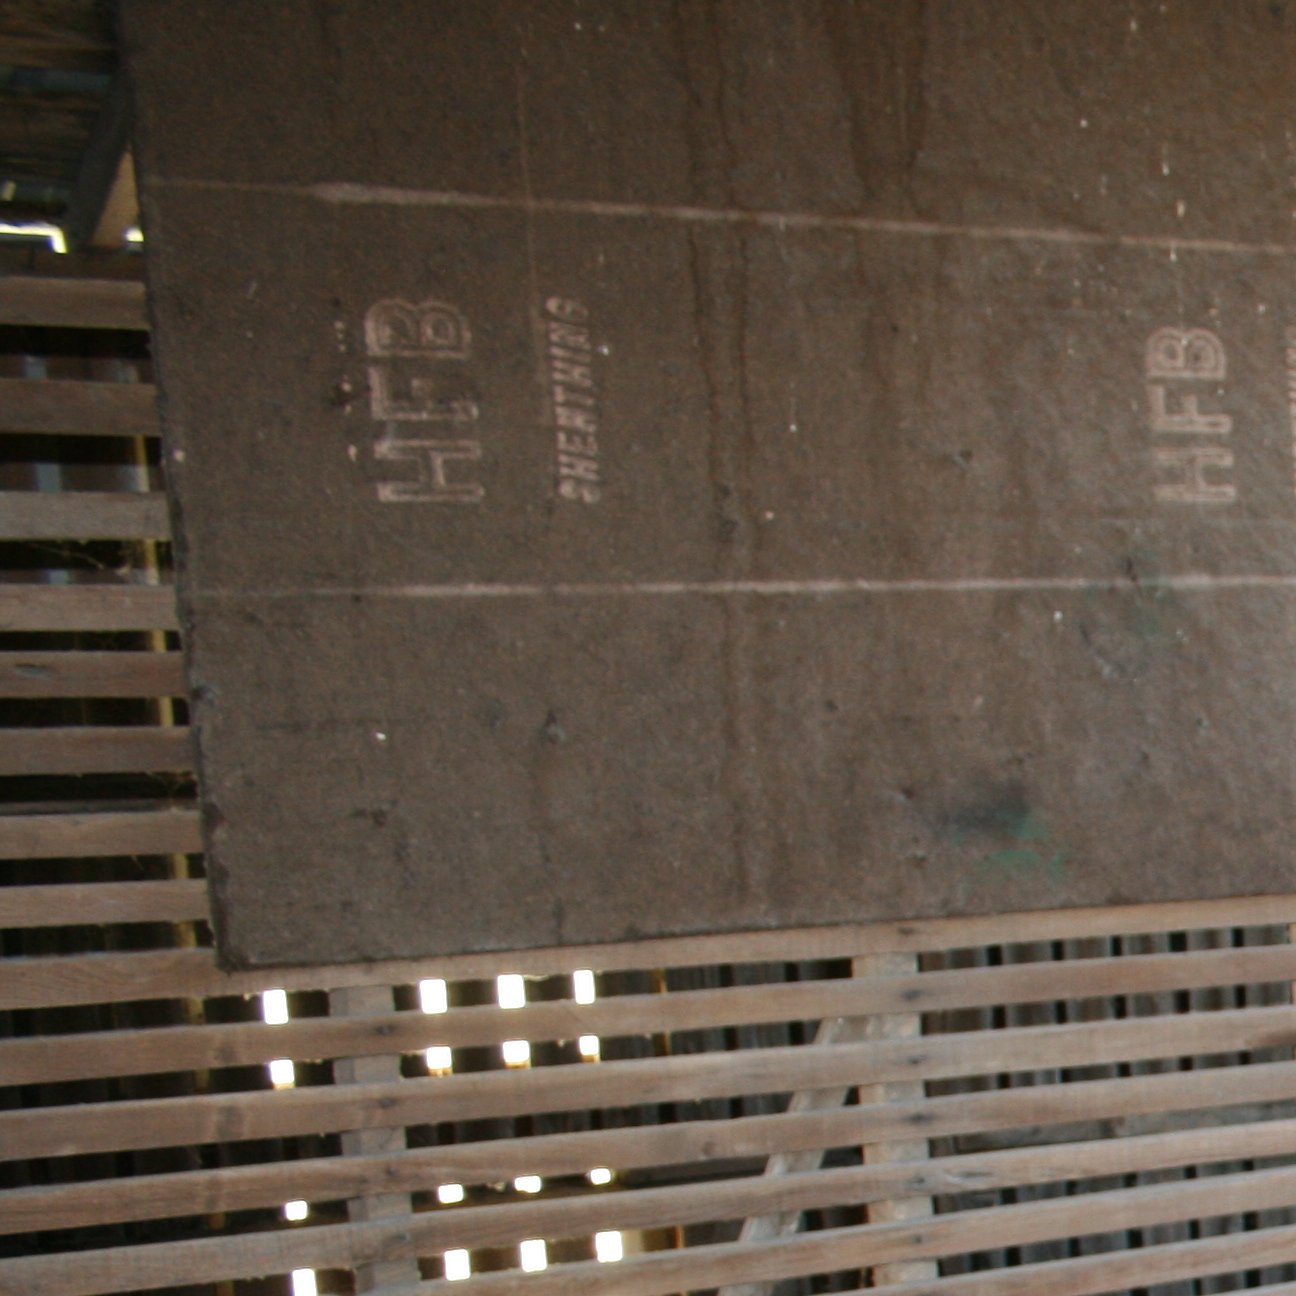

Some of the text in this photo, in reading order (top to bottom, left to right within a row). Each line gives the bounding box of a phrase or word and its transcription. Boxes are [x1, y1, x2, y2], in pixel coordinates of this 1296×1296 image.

[364, 297, 485, 503] HFB
[545, 295, 602, 504] SHEATHING
[1145, 325, 1236, 502] HFB
